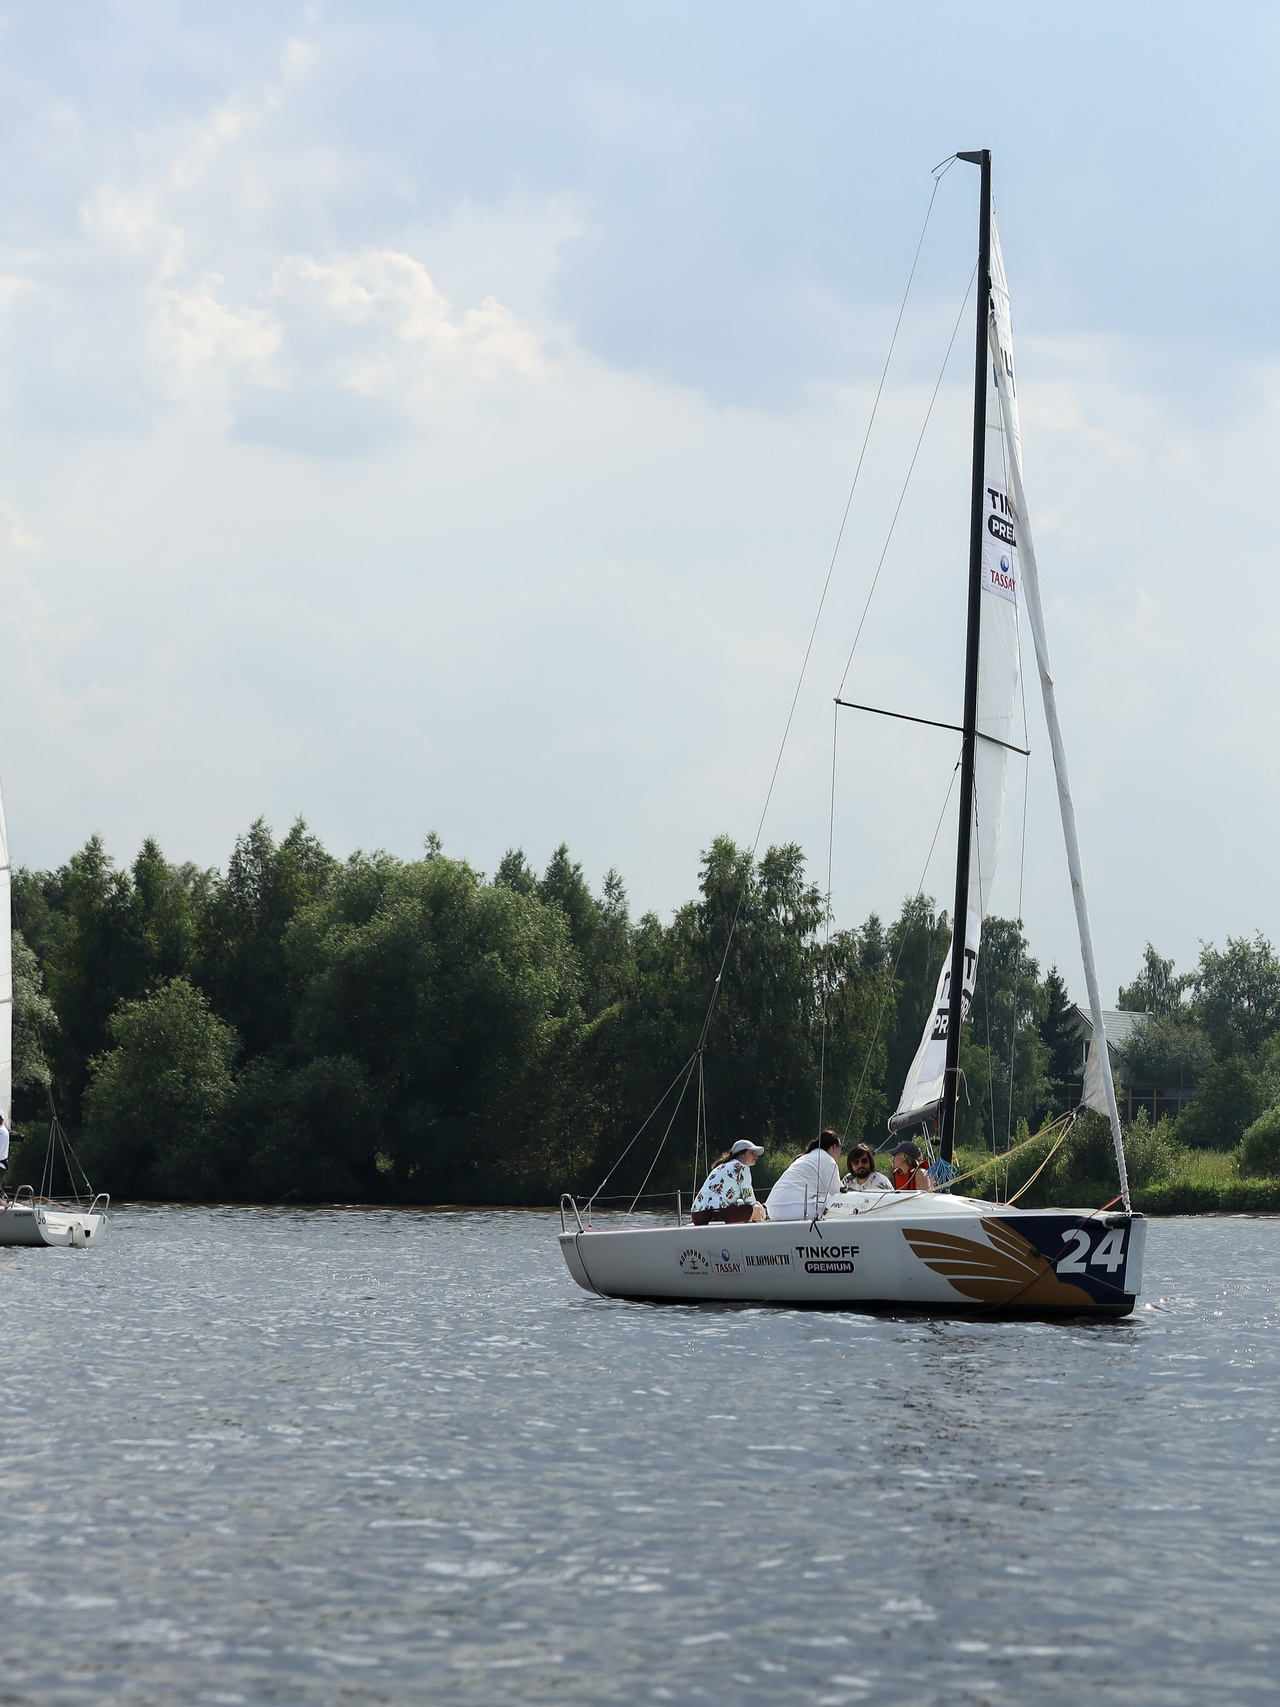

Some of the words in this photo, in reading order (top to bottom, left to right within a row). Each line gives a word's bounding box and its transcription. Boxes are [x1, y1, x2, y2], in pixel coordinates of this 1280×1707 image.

[990, 569, 1017, 593] TASSAY
[37, 1217, 47, 1225] 20
[796, 1246, 860, 1259] TINKOFF
[1056, 1228, 1126, 1274] 24
[715, 1263, 741, 1273] TASSAY
[807, 1263, 852, 1272] PREMIUM
